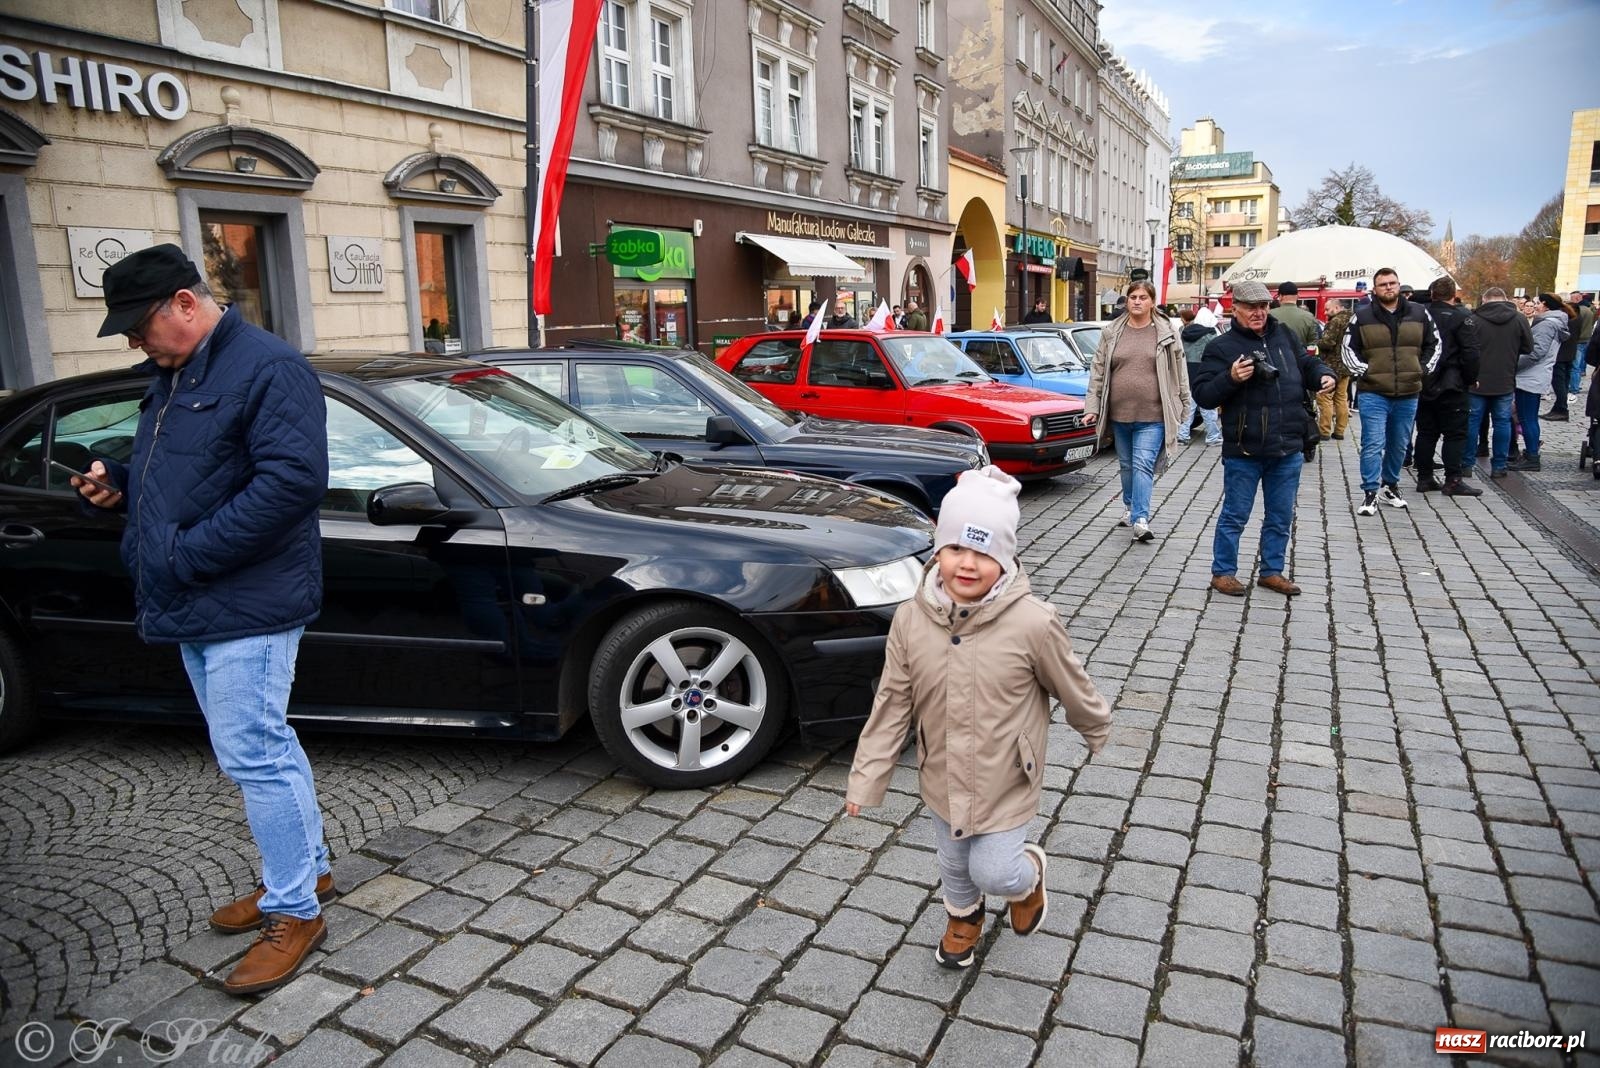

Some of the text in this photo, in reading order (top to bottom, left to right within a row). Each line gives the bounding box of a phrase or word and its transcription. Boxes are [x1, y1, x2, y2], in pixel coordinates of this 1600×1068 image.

[0, 44, 189, 121] SHIRO
[767, 211, 820, 238] Manufaktura
[821, 219, 846, 240] Lodów
[611, 239, 655, 253] żabka
[1016, 233, 1057, 258] APTEKA
